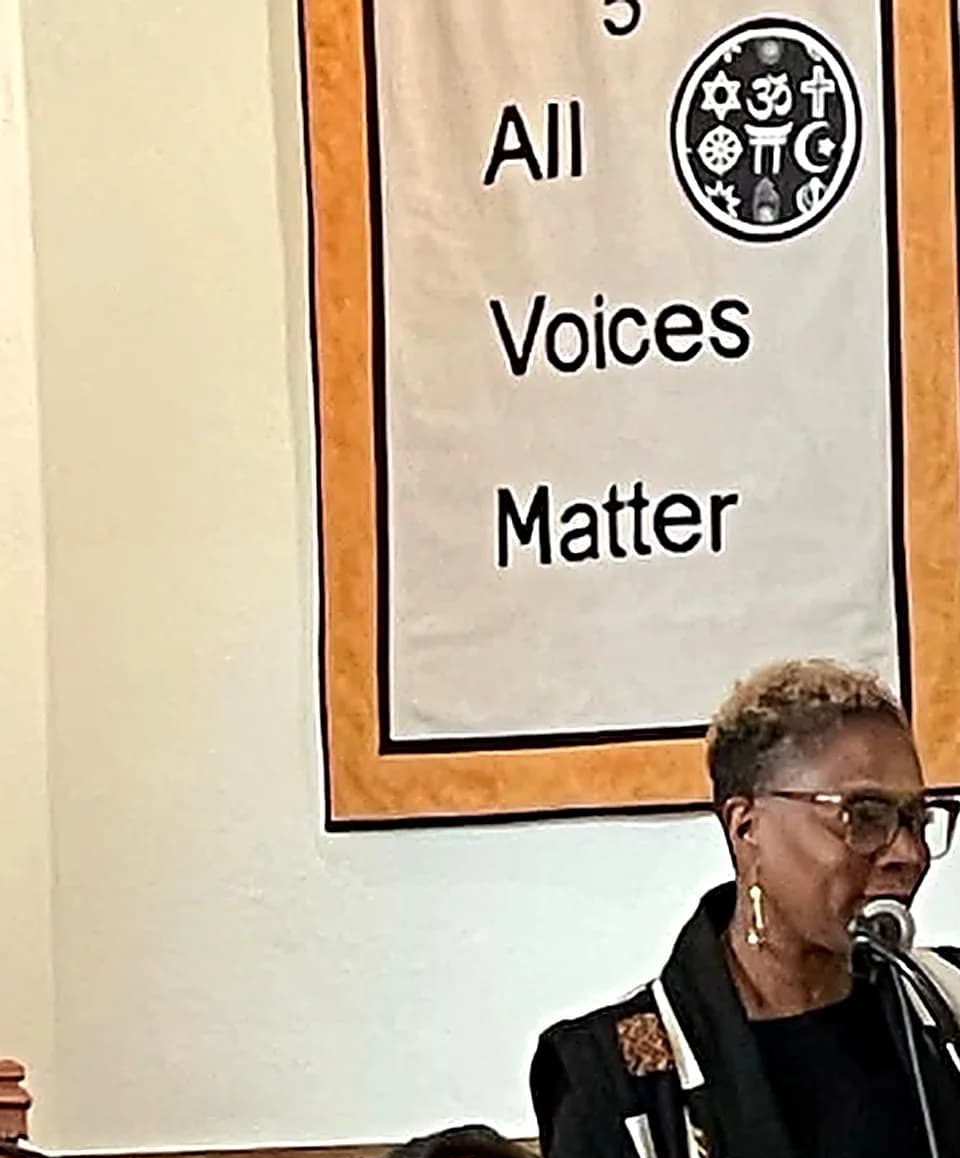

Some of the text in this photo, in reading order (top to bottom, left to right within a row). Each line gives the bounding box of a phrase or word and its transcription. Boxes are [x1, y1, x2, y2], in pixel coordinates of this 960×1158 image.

[483, 100, 583, 186] All
[489, 293, 751, 377] Voices
[497, 480, 740, 568] Matter
